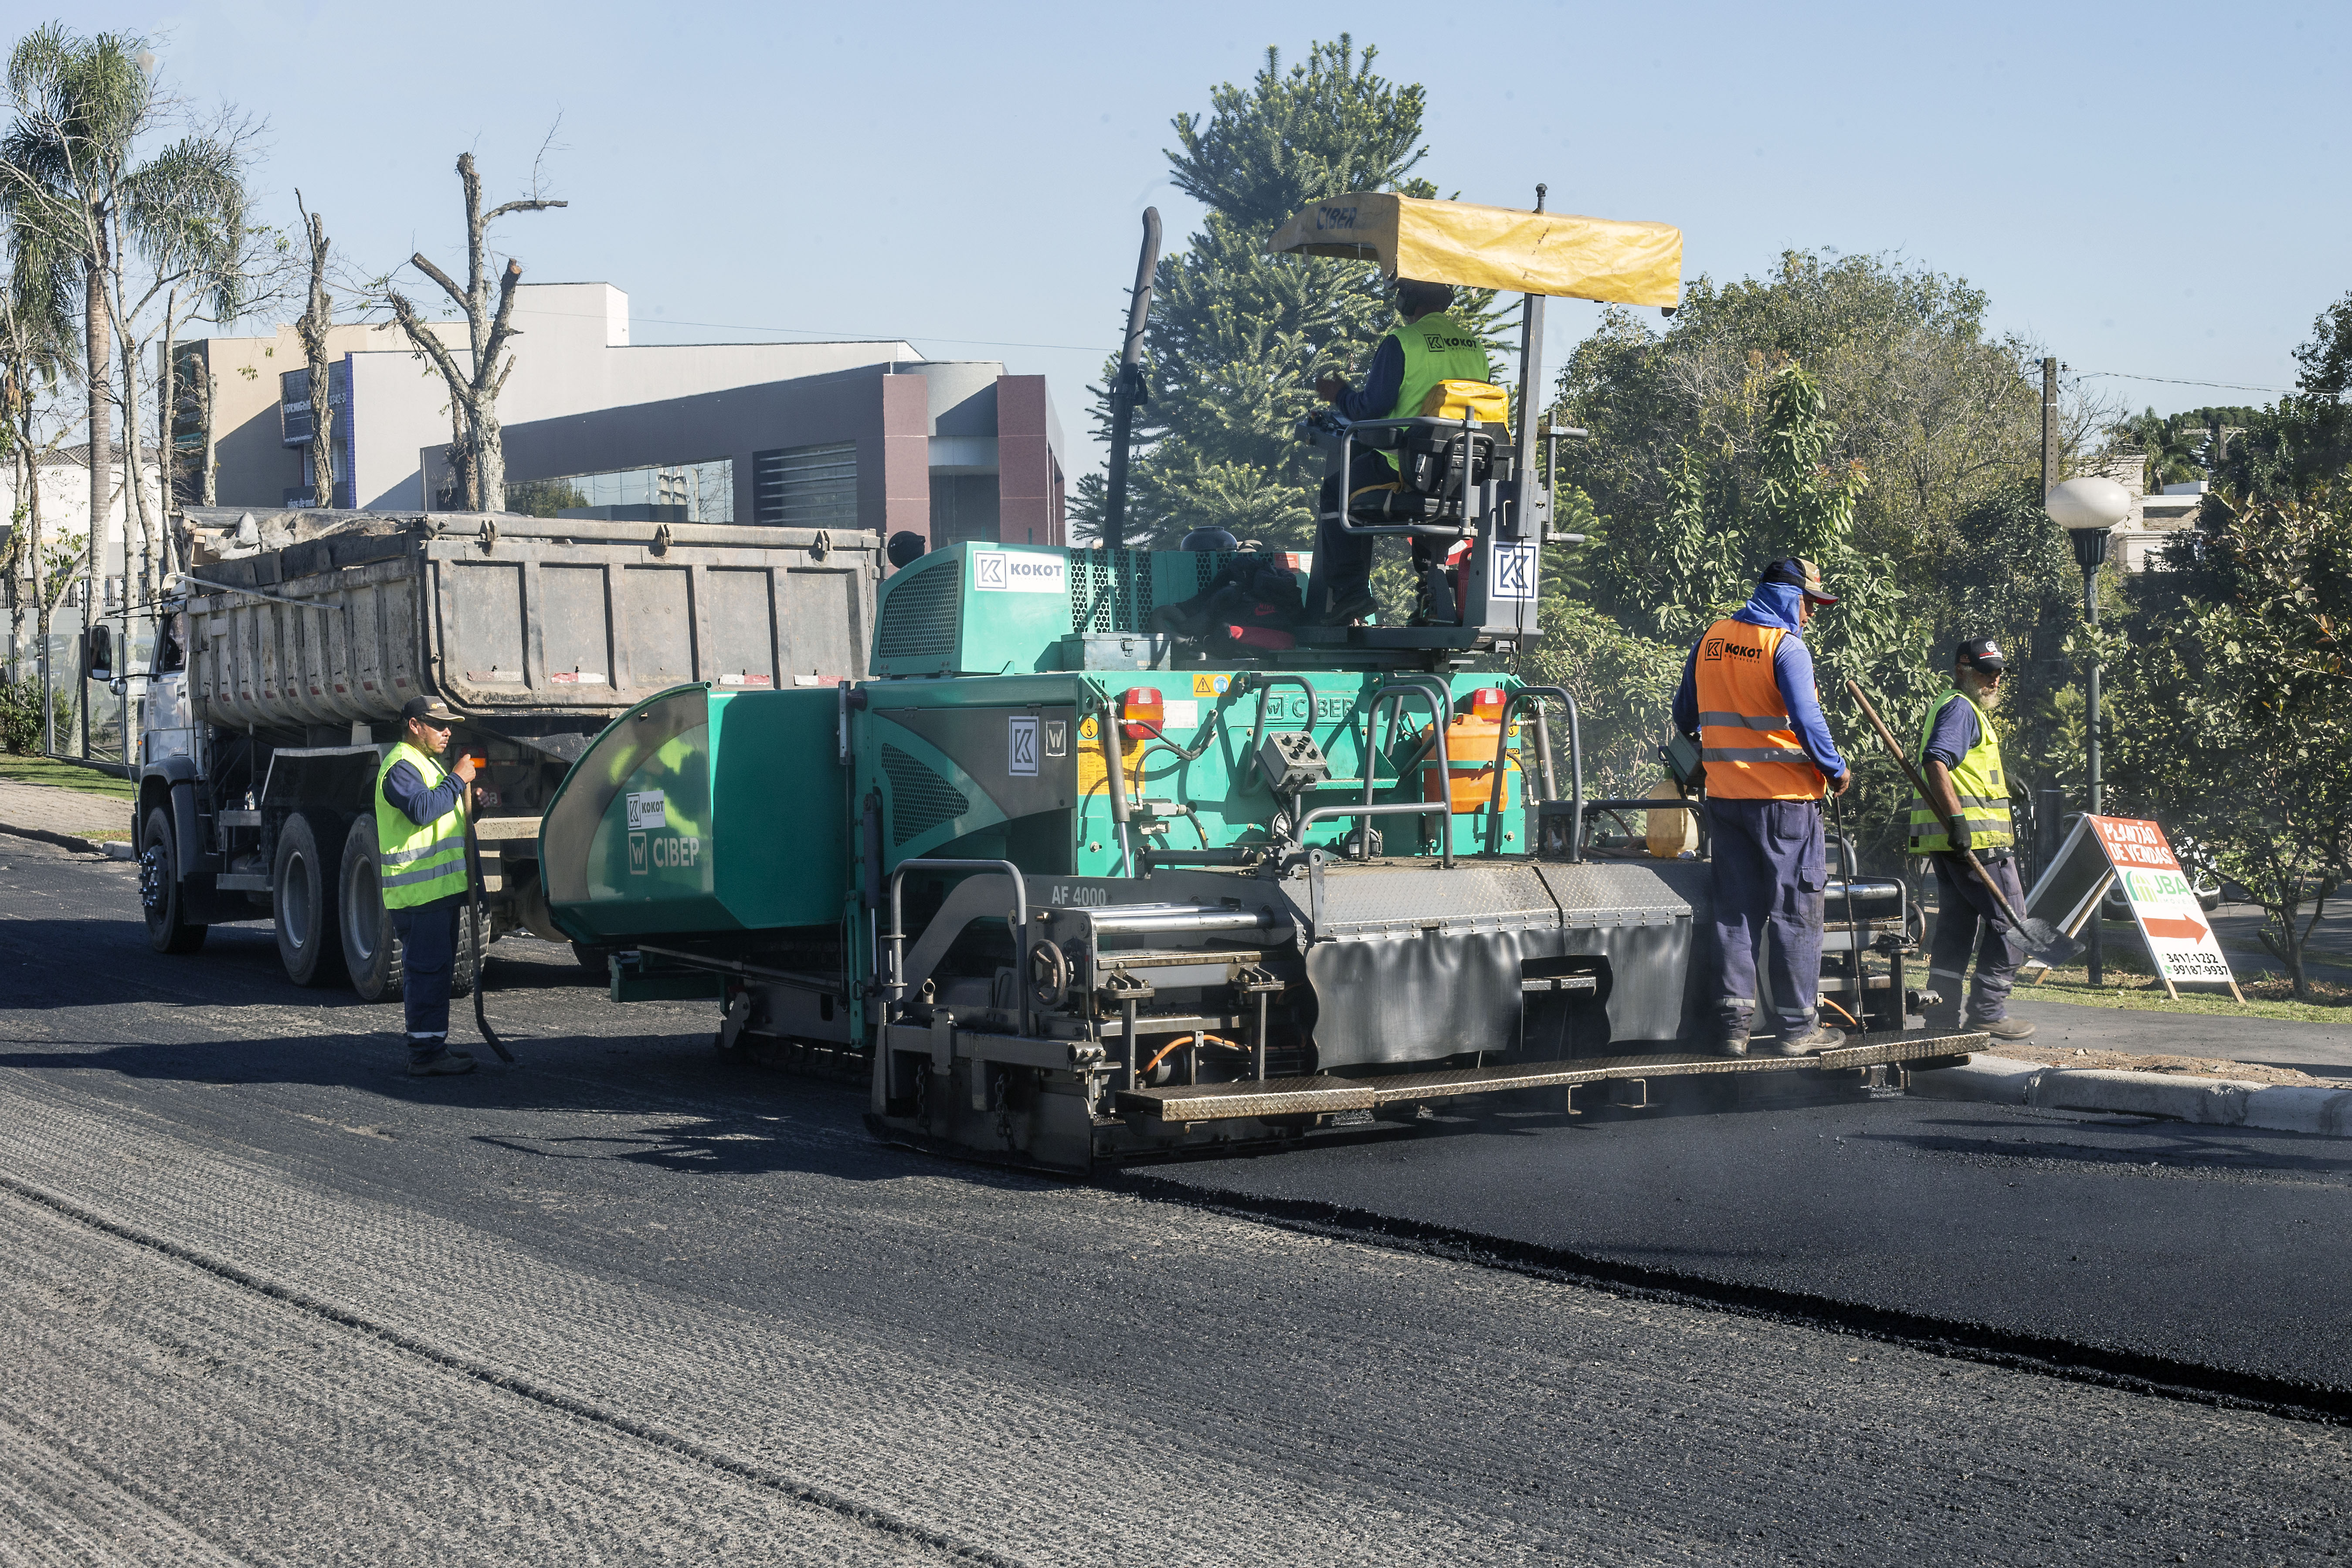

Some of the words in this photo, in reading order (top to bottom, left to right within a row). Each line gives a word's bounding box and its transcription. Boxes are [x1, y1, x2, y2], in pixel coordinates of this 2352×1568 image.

[1317, 207, 1357, 230] CIBER
[1443, 338, 1476, 348] KOKOT
[1011, 563, 1062, 576] KOKOT
[1725, 643, 1762, 658] KOKOT
[1292, 697, 1356, 717] CBER
[642, 801, 664, 814] KOKOT
[2103, 821, 2158, 844] PLANTÃO
[2108, 842, 2128, 861] DE
[2124, 844, 2173, 865] VENDAS
[2154, 875, 2191, 896] JBA
[1052, 886, 1069, 904] AF
[1073, 886, 1106, 906] 4000
[2166, 953, 2219, 964] 3417-1232
[2173, 965, 2228, 975] 99187-9937
